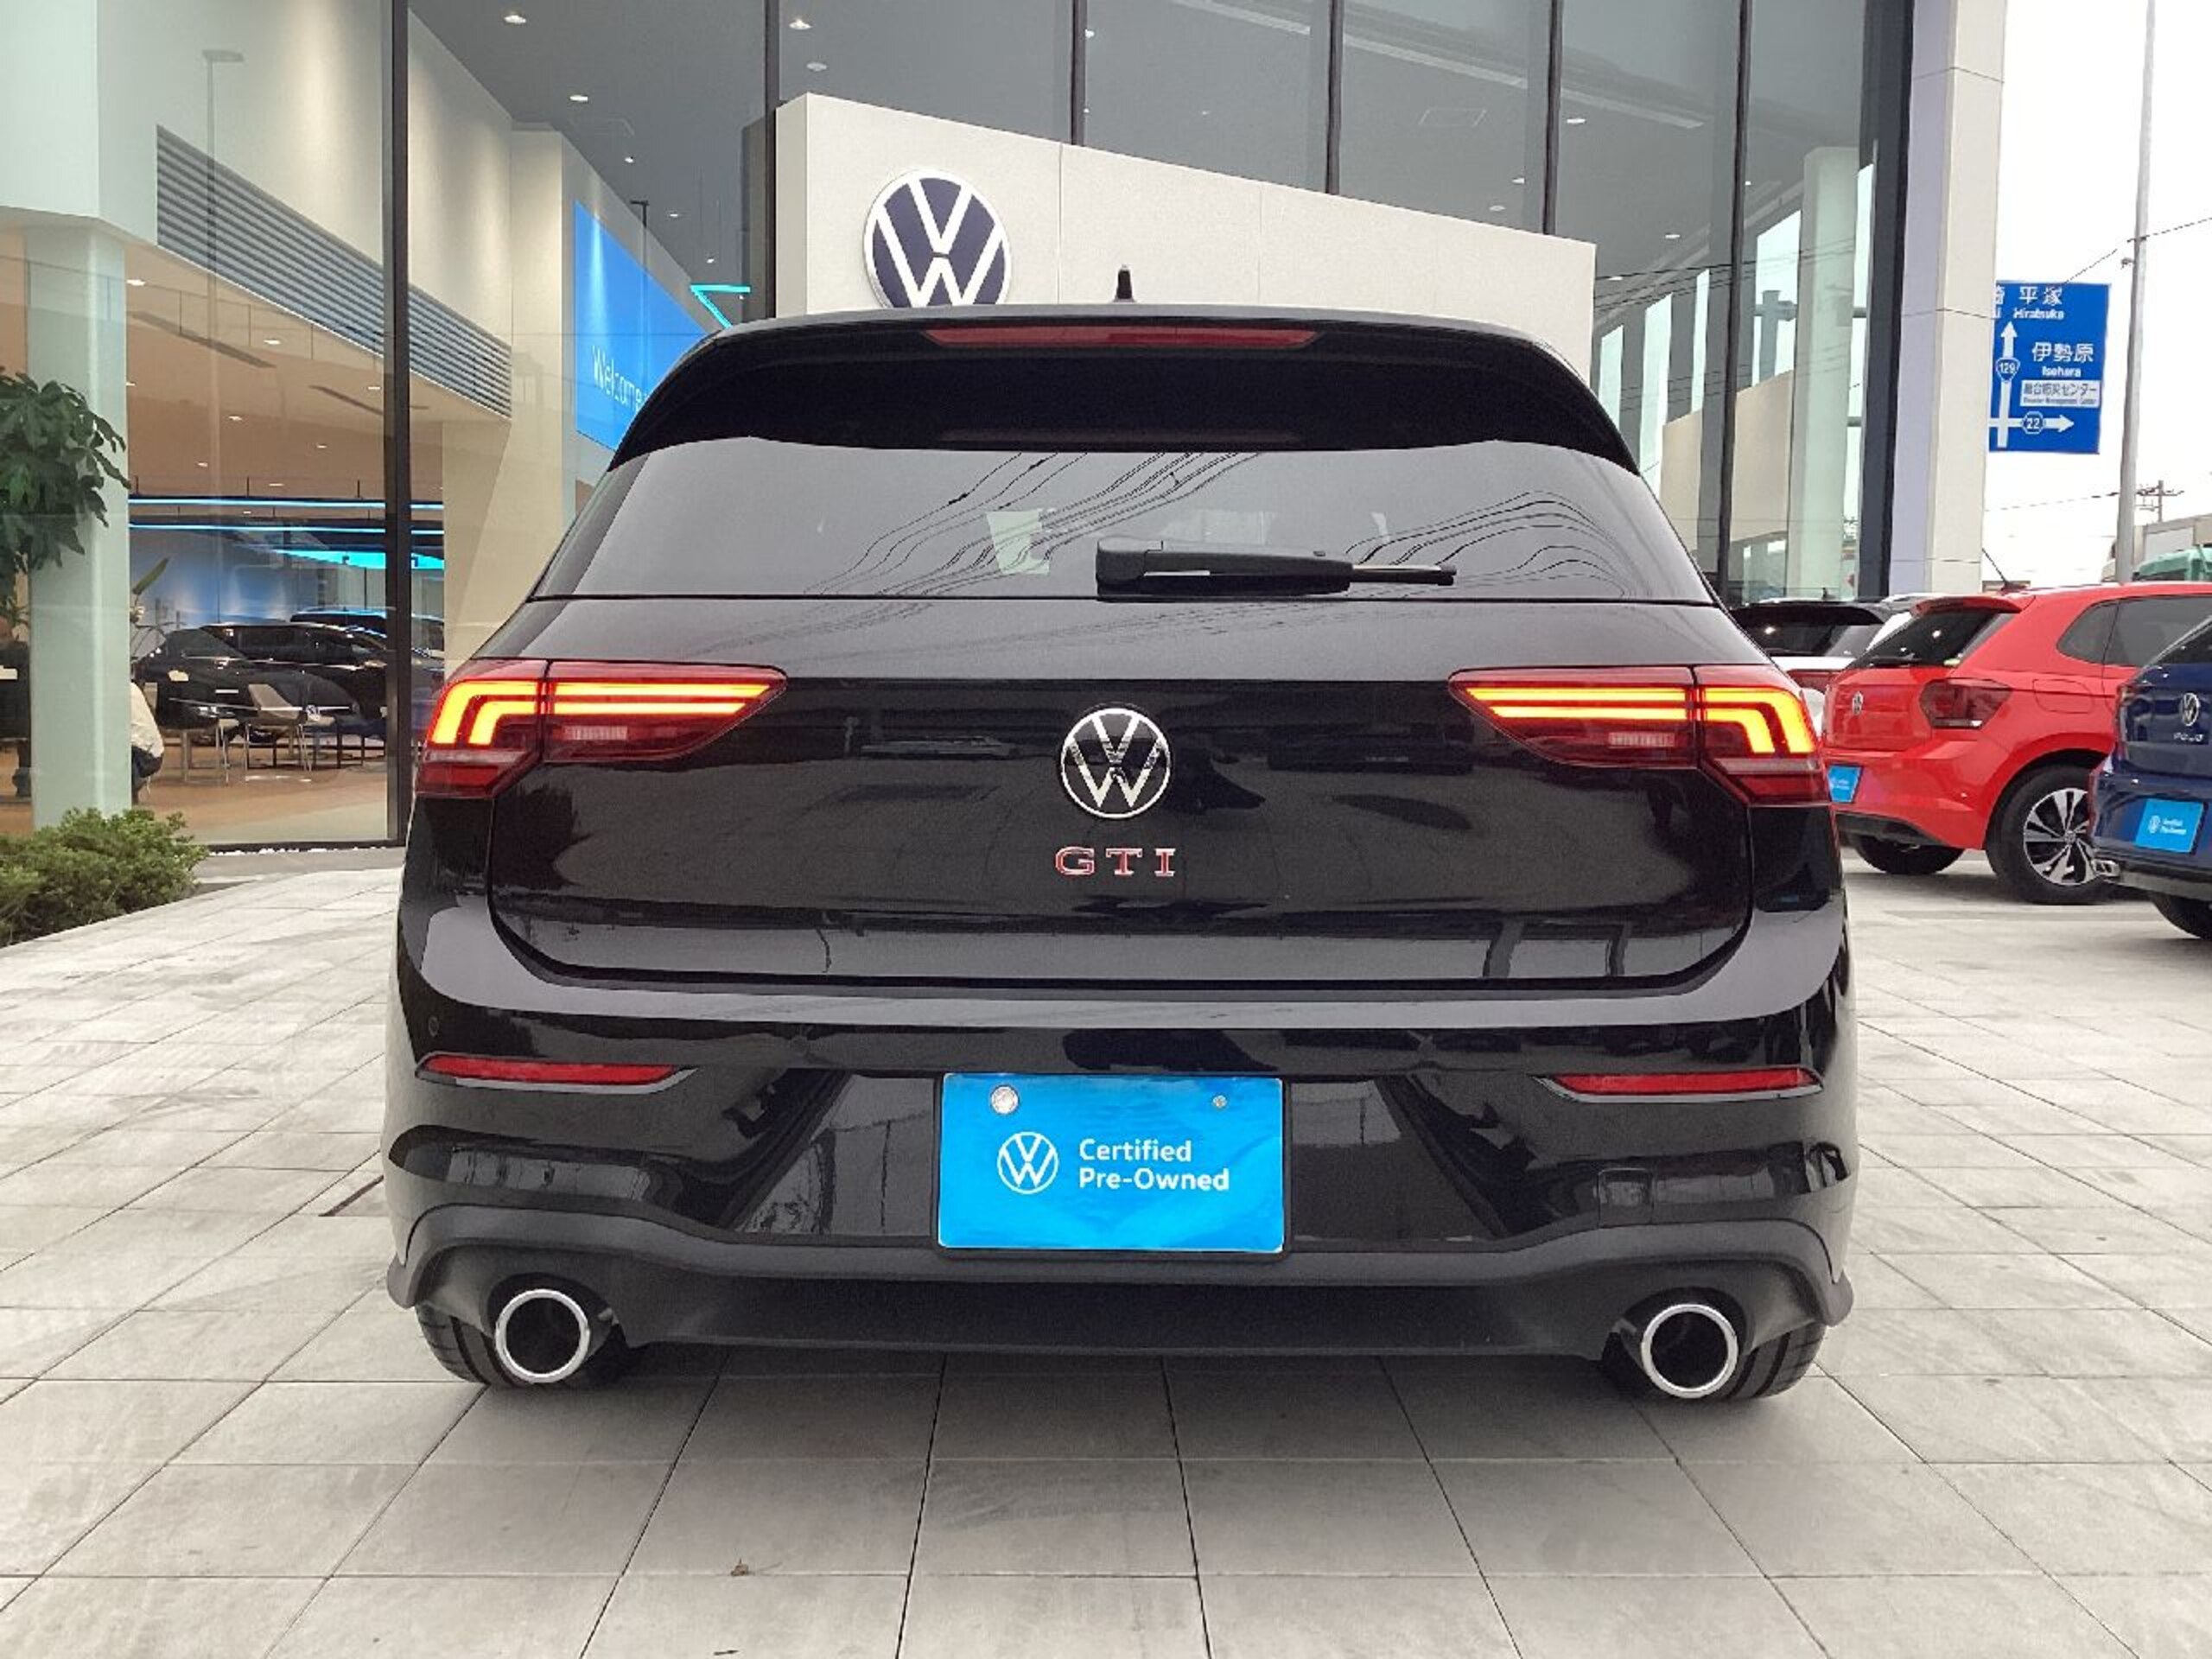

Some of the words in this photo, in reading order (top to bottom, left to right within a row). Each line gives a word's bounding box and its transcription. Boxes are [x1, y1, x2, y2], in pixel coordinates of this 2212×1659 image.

[2019, 286, 2063, 305] 平塚
[2013, 308, 2064, 320] Hiratsuka
[2031, 341, 2094, 362] 伊勢原
[591, 345, 643, 411] Welcome
[1999, 362, 2016, 374] 129
[2042, 366, 2081, 378] Isehara
[2027, 418, 2040, 429] 22
[1060, 708, 1171, 817] VW
[1055, 846, 1176, 877] GTI
[1079, 1138, 1192, 1162] Certified
[997, 1131, 1058, 1194] VW
[1079, 1167, 1230, 1192] Pre-Owned
